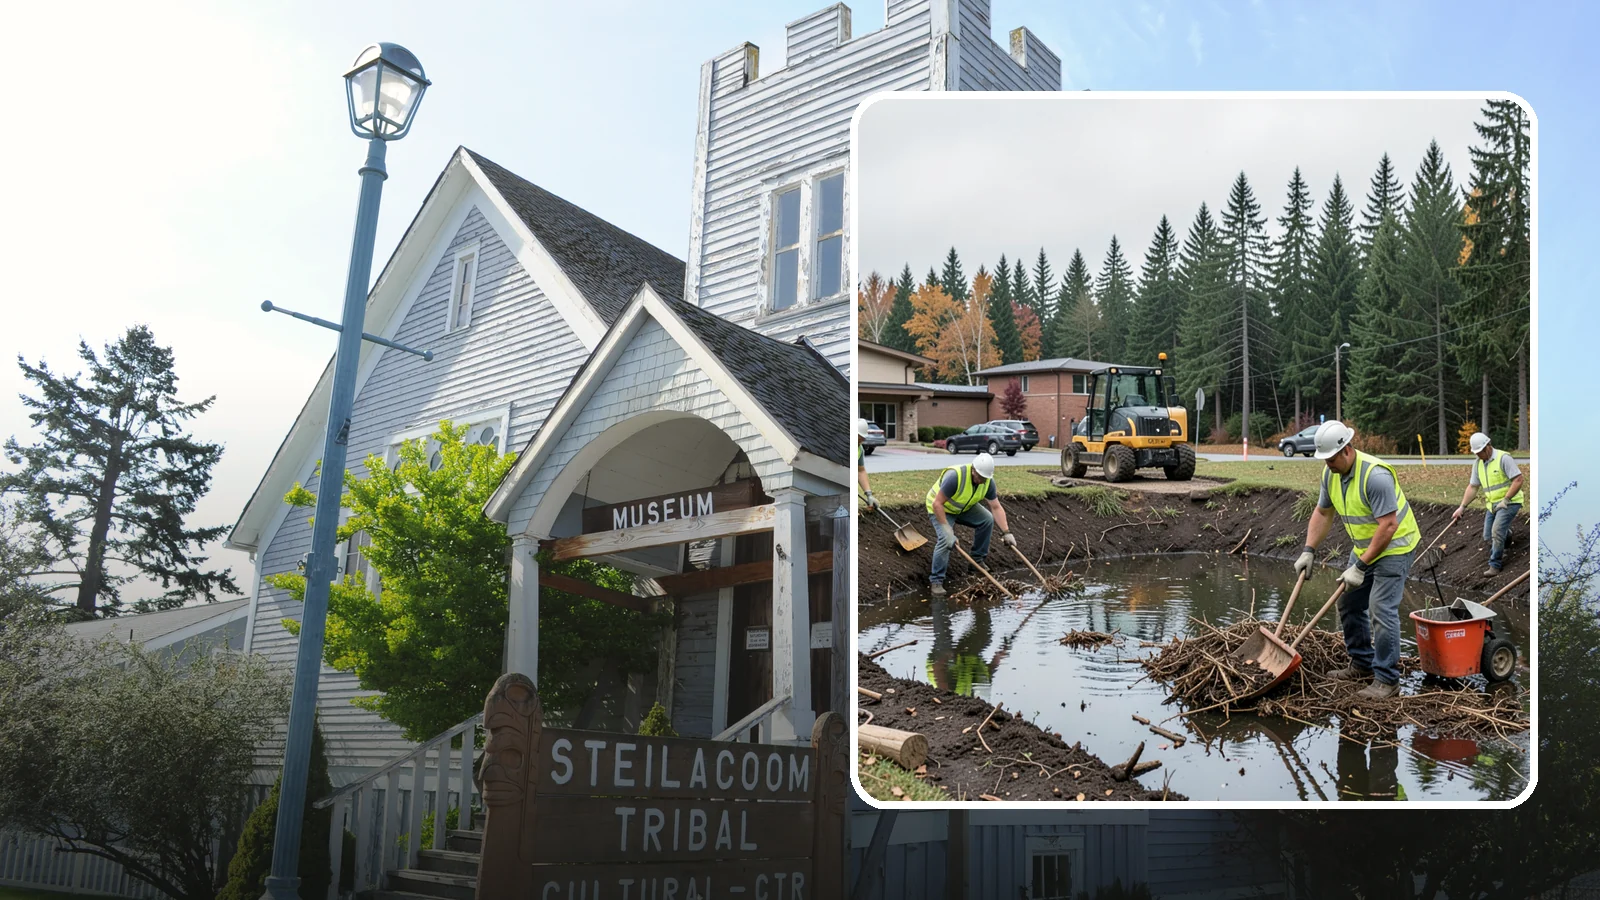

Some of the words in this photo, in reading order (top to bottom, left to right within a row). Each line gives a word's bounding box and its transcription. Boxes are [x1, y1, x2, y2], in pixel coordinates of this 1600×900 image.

[613, 491, 713, 531] MUSEUM
[550, 738, 809, 792] STEILACOOM
[615, 806, 757, 851] TRIBAL
